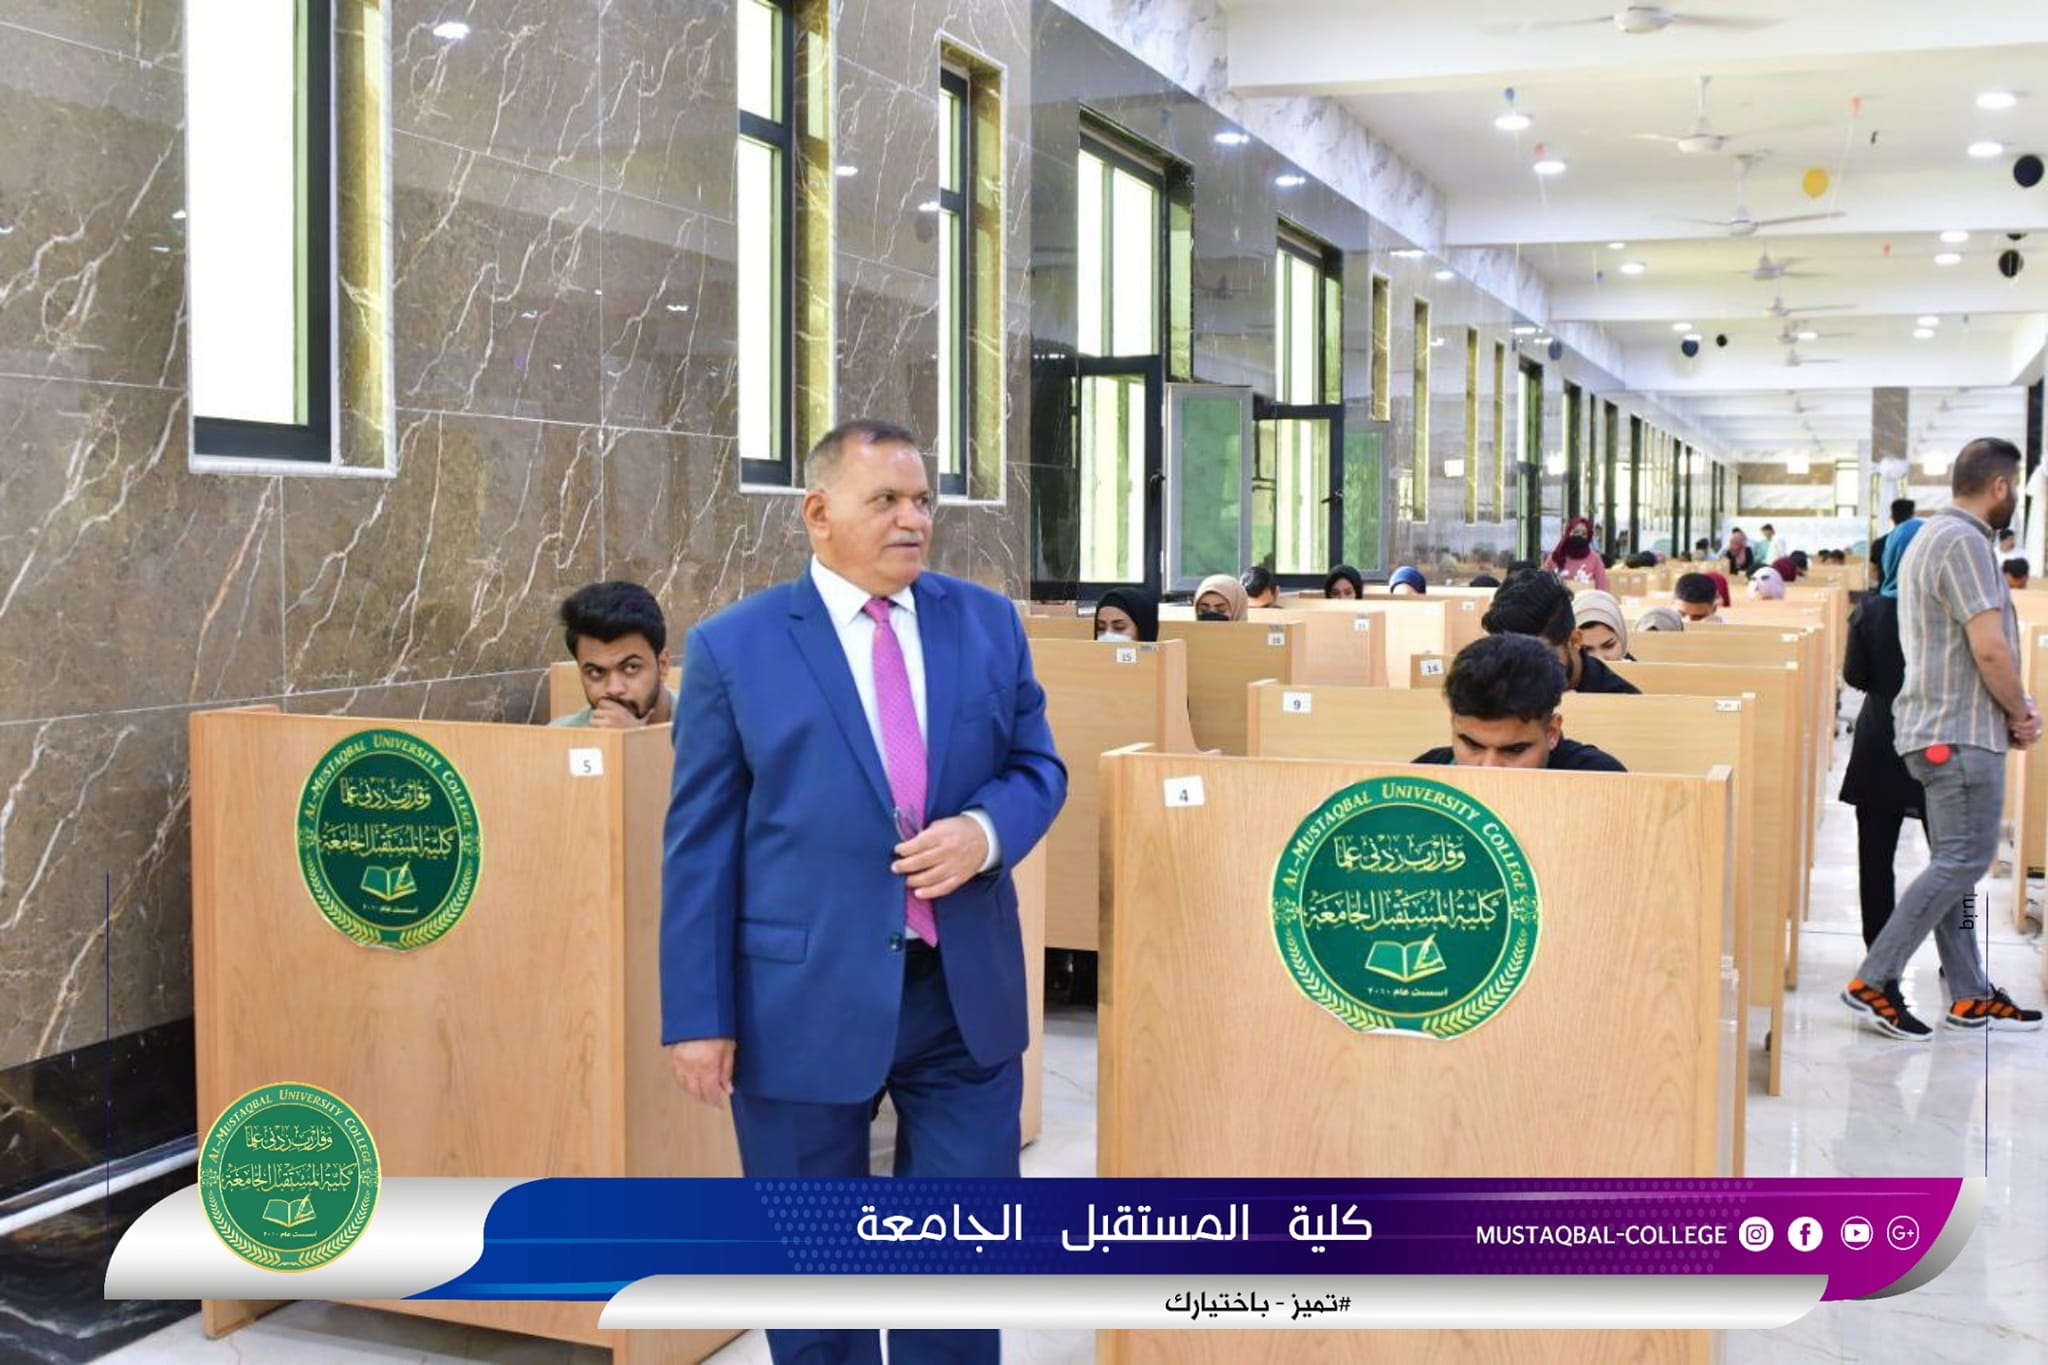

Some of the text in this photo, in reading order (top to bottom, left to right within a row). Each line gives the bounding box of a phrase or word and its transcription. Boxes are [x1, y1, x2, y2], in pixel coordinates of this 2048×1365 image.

[1293, 699, 1302, 711] 9
[583, 759, 592, 774] 5
[1179, 788, 1189, 803] 4
